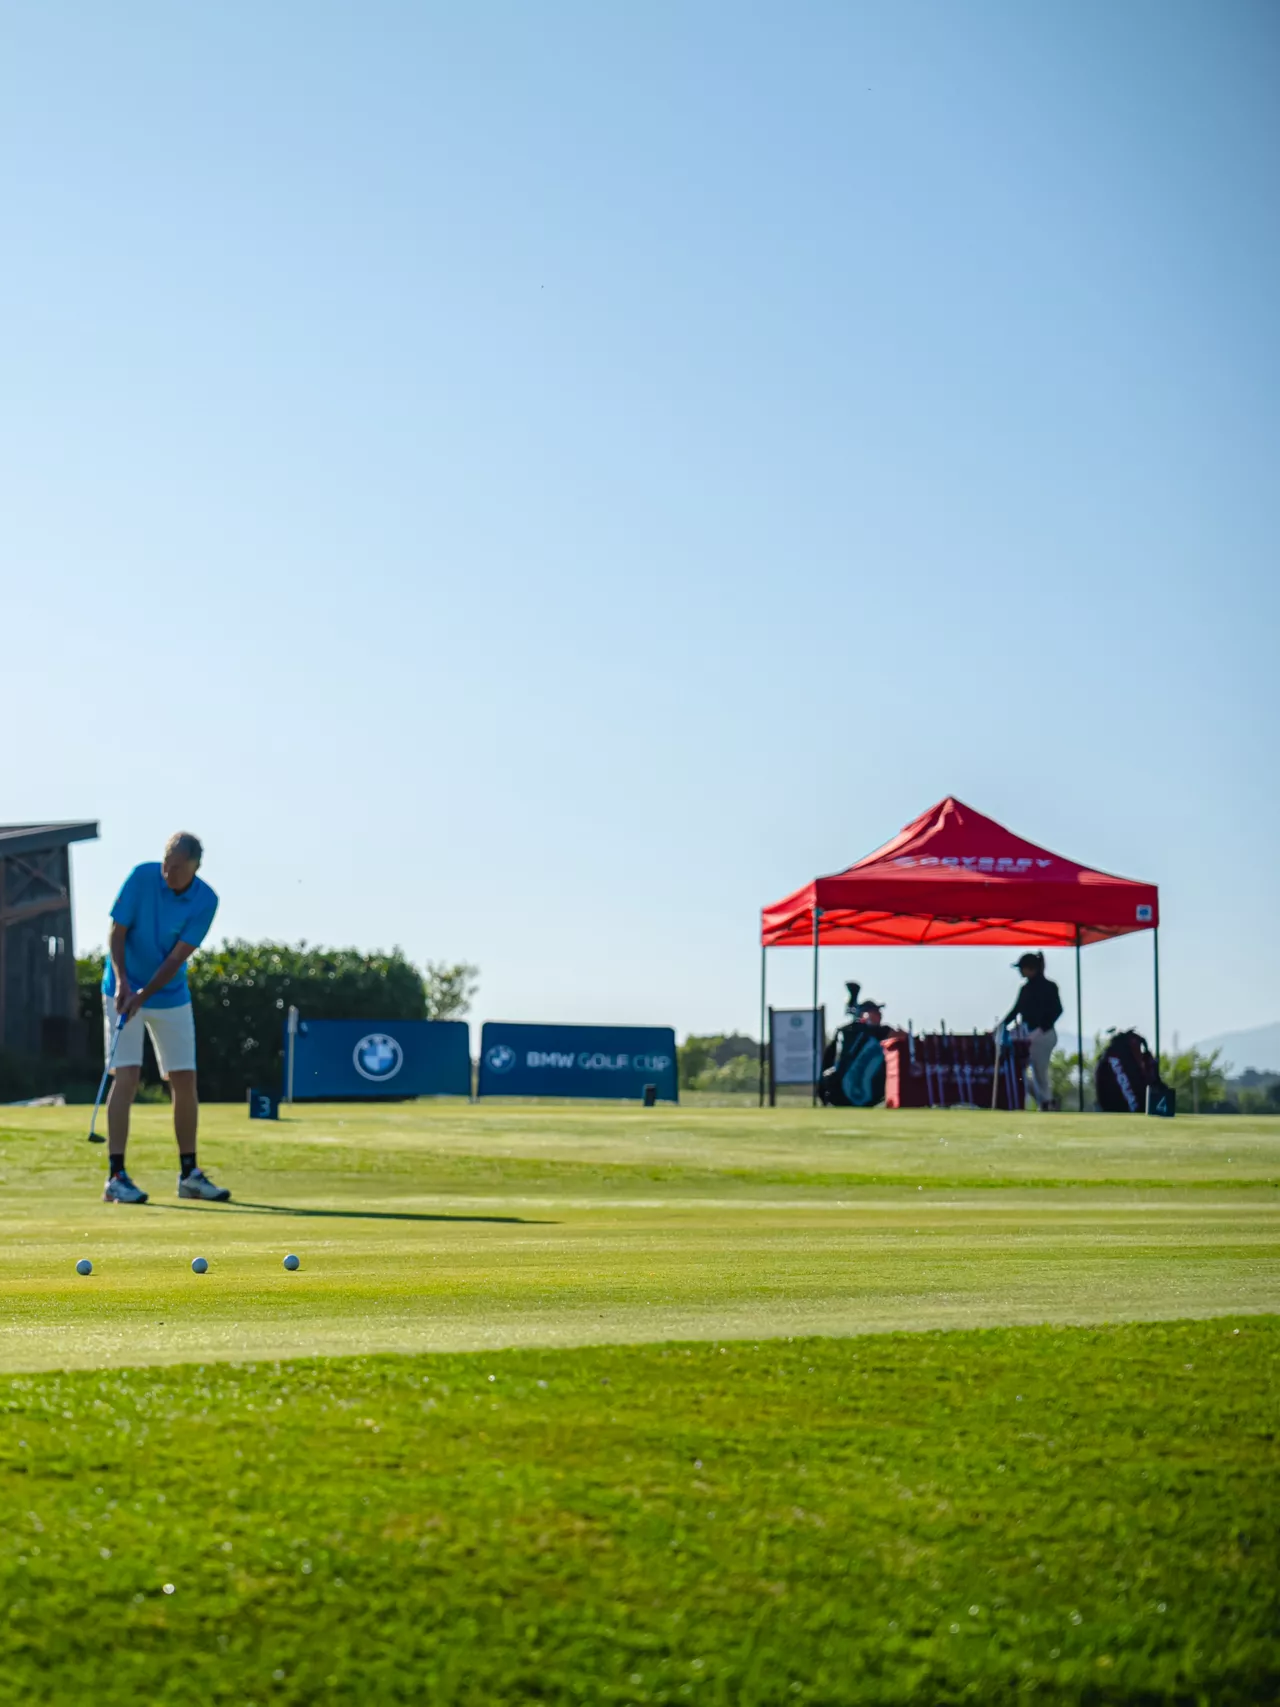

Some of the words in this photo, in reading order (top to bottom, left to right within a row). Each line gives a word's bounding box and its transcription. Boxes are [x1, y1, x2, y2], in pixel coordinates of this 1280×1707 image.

[526, 1051, 575, 1068] BMW
[578, 1052, 629, 1070] GOLF
[633, 1054, 672, 1072] CUP
[258, 1096, 271, 1118] 3
[1155, 1095, 1168, 1113] 4
